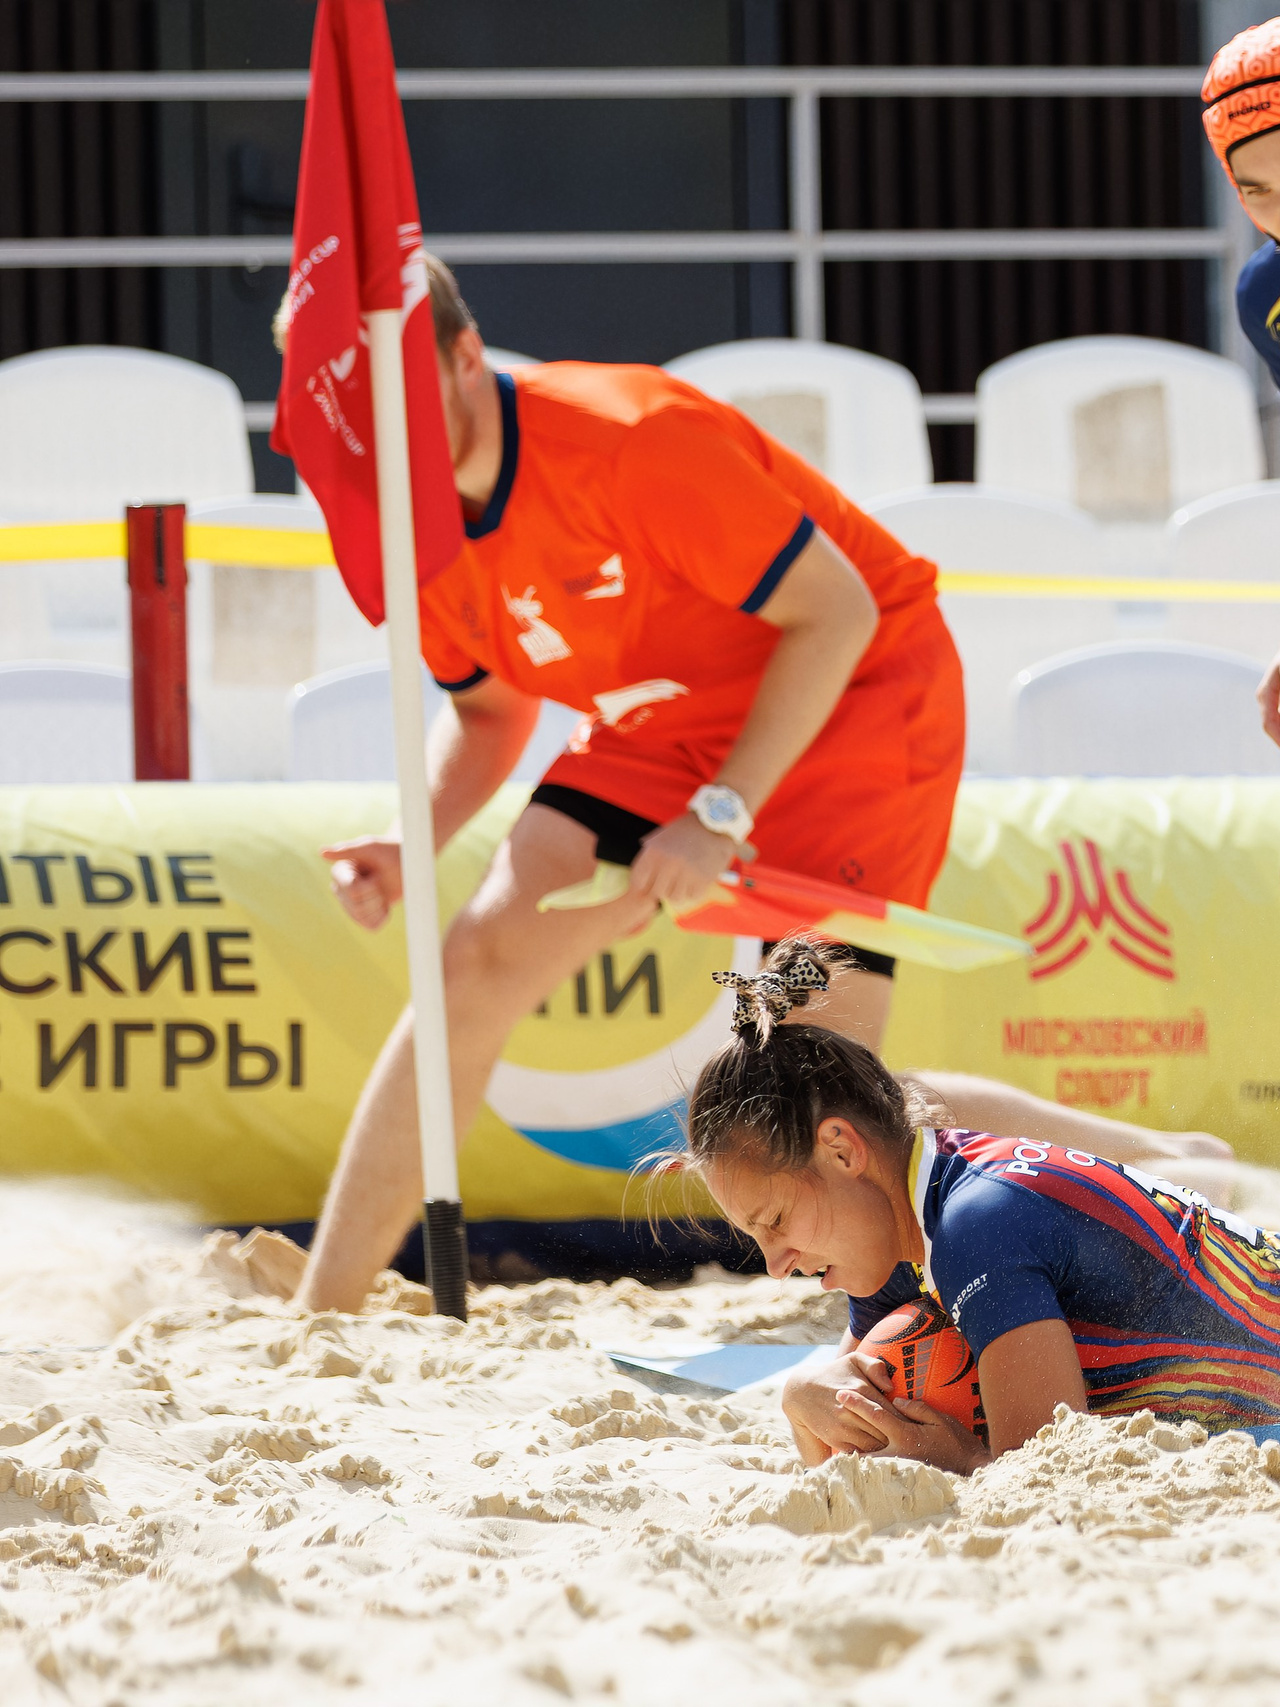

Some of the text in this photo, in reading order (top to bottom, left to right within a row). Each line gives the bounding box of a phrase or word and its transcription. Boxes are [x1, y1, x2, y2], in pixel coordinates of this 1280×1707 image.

[0, 930, 256, 994] СКИЕ
[38, 1022, 303, 1088] ИГРЫ
[1003, 1007, 1209, 1055] МОСКОВСКИЙ
[1056, 1068, 1152, 1109] СПОРТ
[956, 1272, 988, 1305] SPORT
